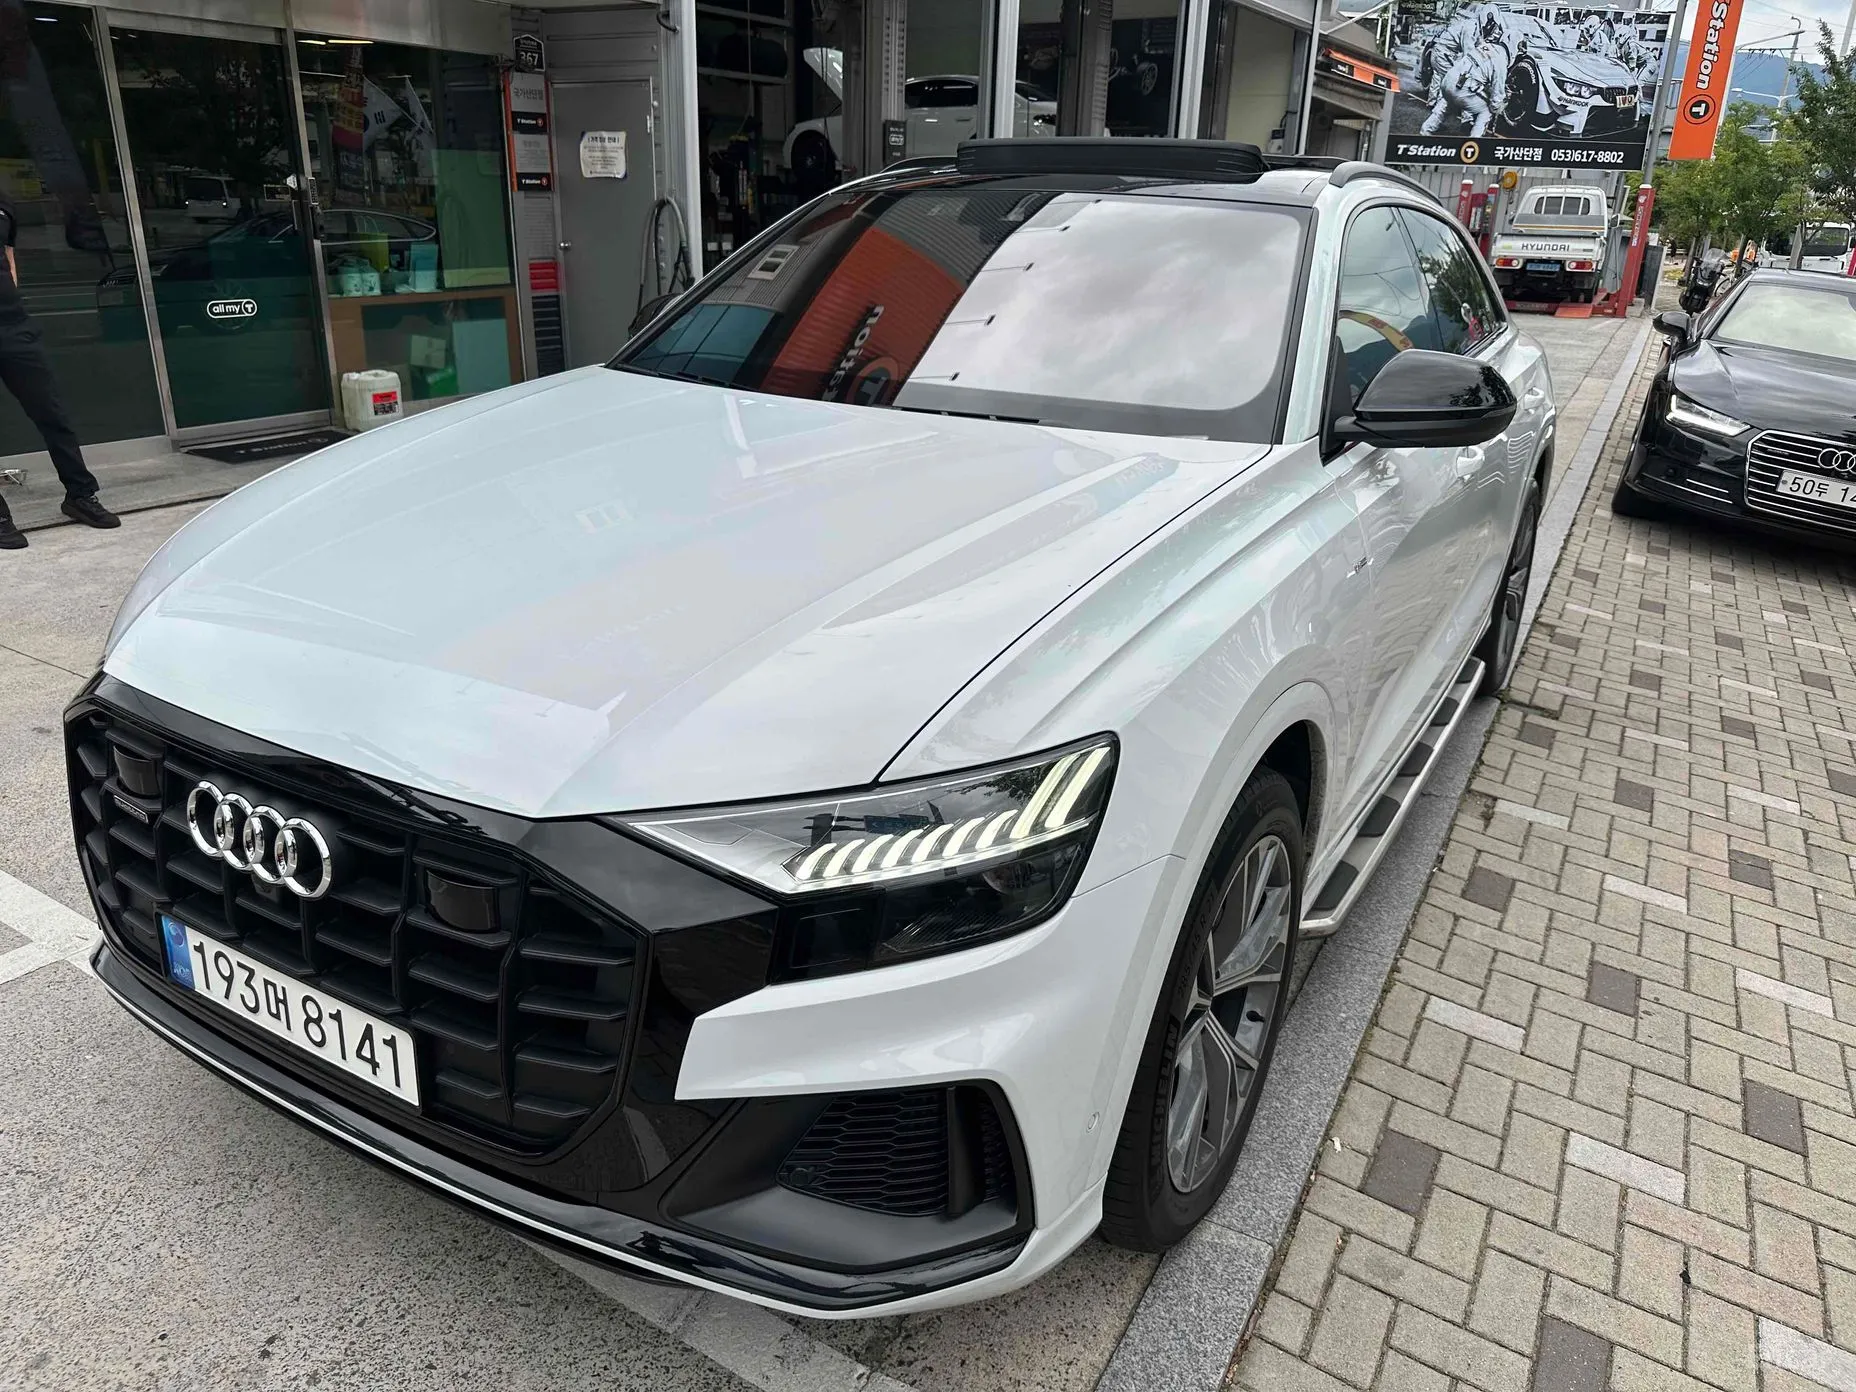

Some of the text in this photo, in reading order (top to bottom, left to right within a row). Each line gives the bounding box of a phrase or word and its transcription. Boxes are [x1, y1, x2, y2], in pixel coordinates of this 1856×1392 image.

[1696, 0, 1728, 90] Station
[1494, 146, 1624, 163] 국가산단점 053)617-8802
[1521, 242, 1570, 252] HYUNDAI
[212, 303, 225, 313] all
[225, 304, 240, 314] my
[1789, 476, 1830, 498] 50두
[193, 941, 401, 1088] 193머 8141
